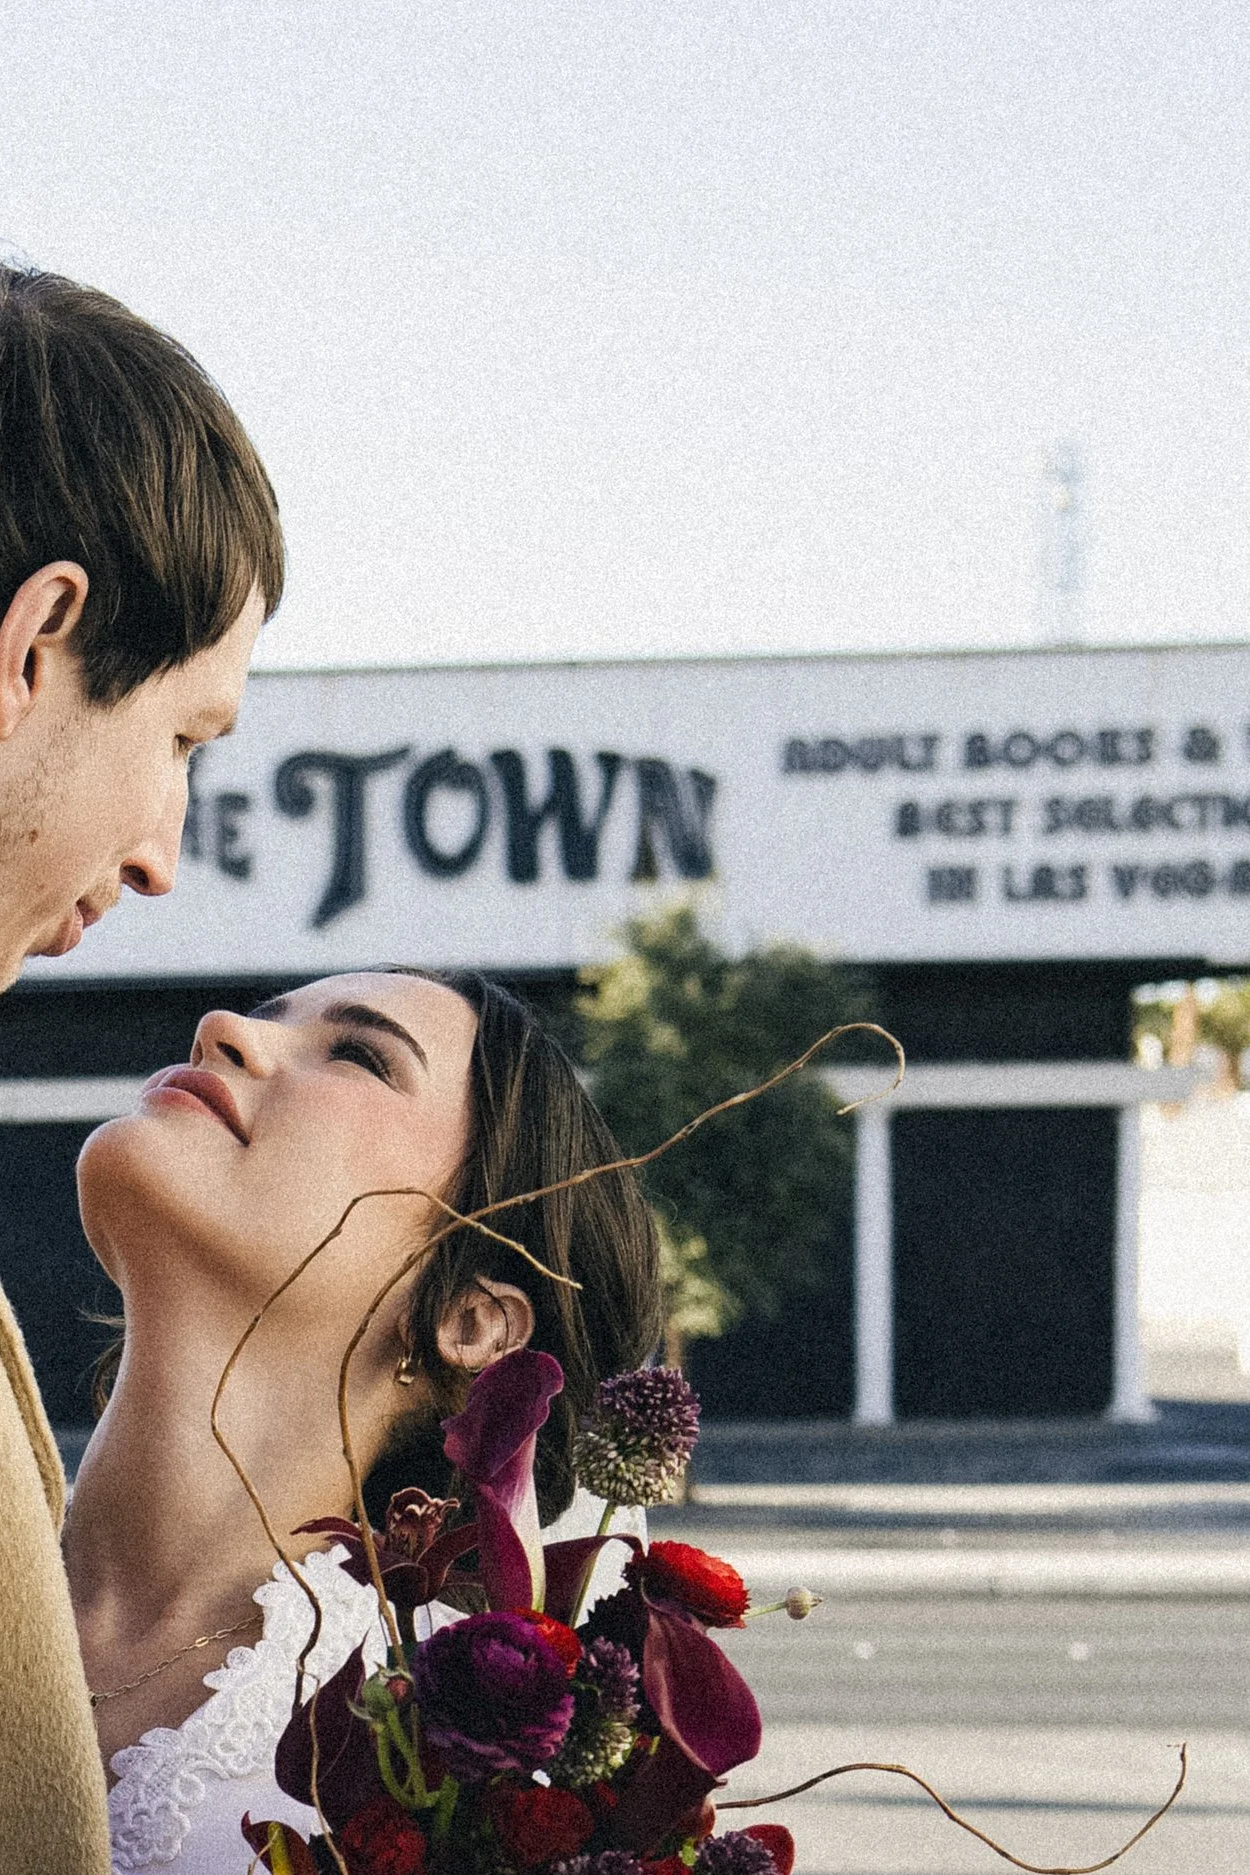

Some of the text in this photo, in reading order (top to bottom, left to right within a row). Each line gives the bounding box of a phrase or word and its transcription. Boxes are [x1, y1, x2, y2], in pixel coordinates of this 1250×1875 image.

[782, 734, 939, 775] ADULT
[962, 728, 1154, 771] BOOKS
[273, 744, 717, 931] TOWN
[894, 798, 1014, 839] BEST
[1003, 862, 1088, 903] LAS
